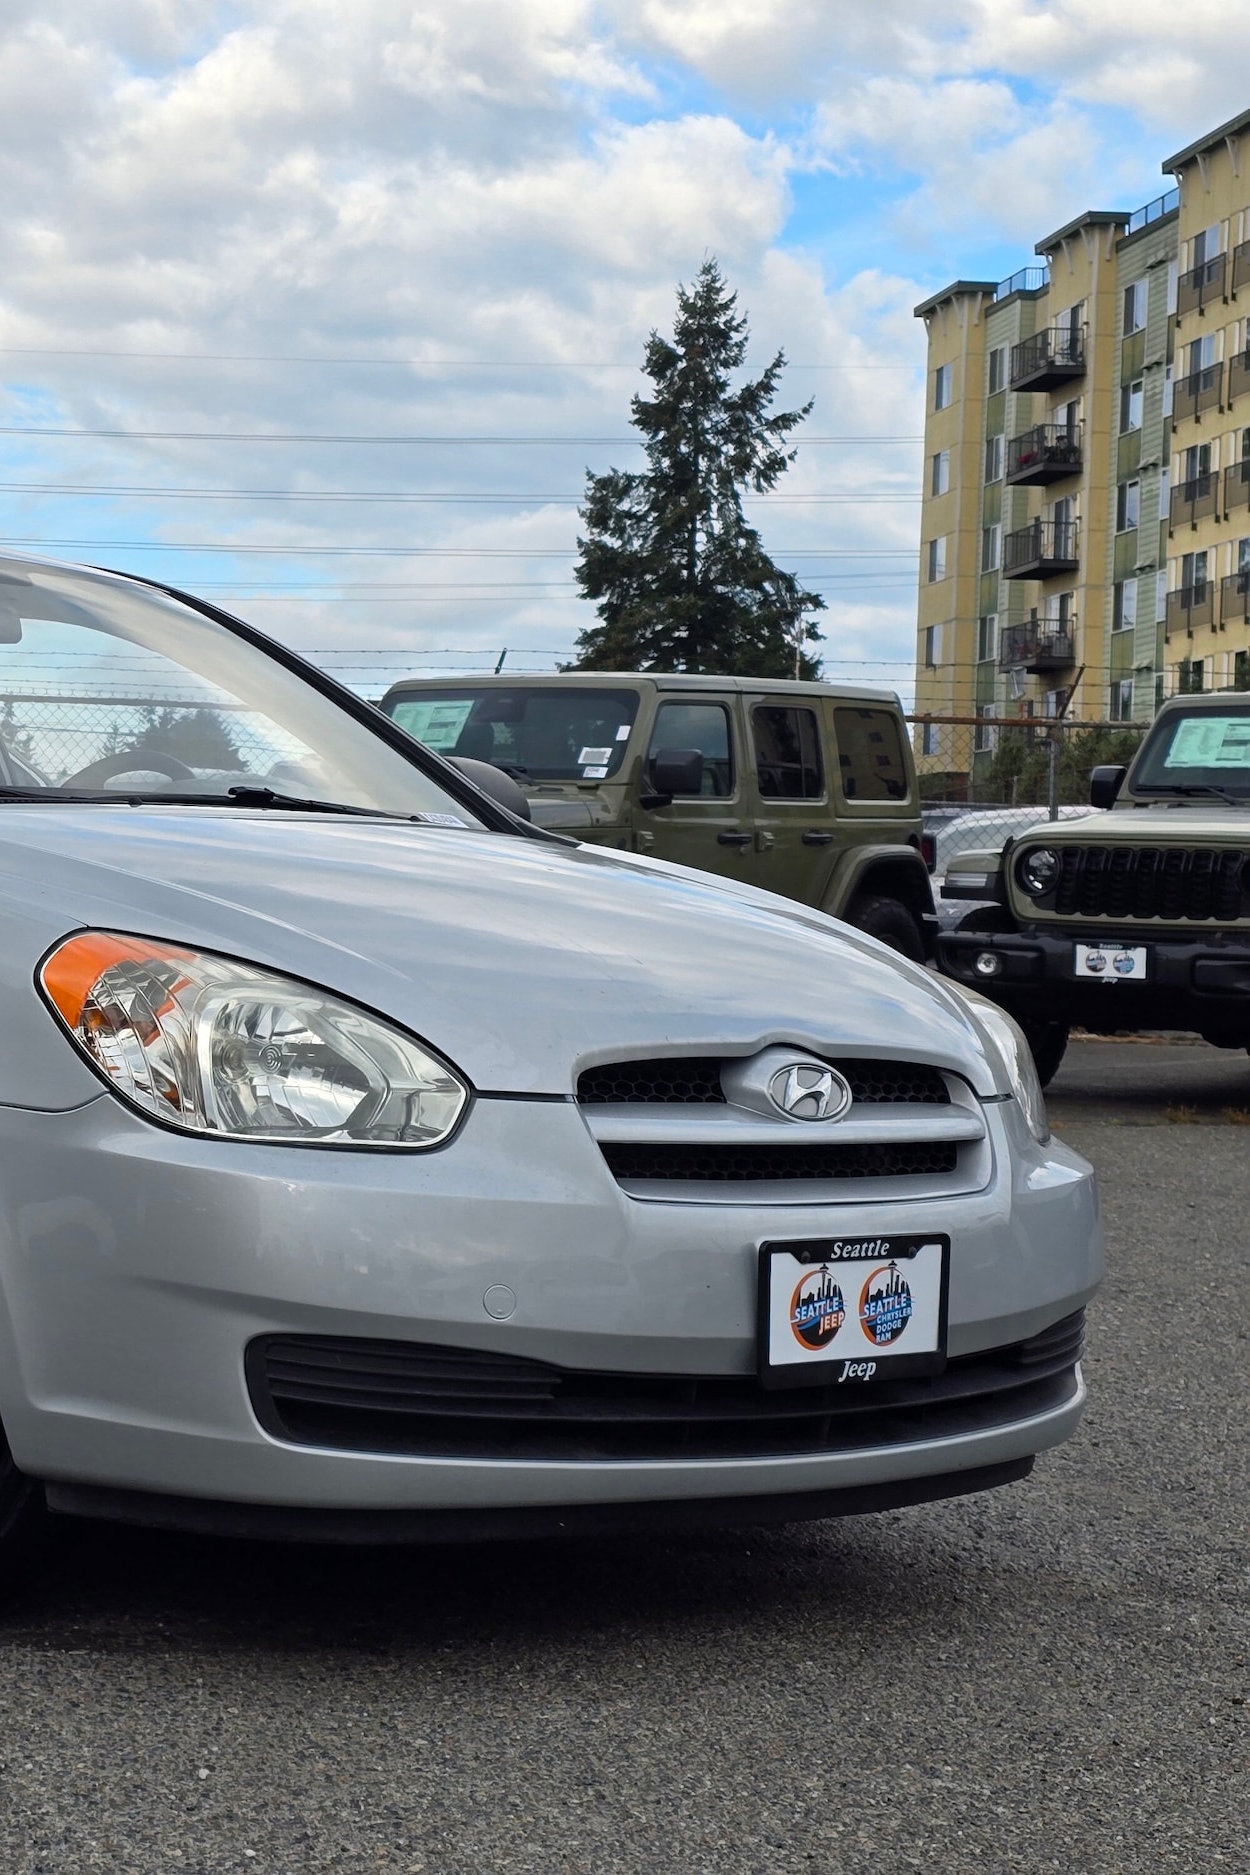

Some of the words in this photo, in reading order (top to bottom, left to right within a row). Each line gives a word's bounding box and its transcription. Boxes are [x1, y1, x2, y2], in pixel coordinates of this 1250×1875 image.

[830, 1239, 890, 1259] Seattle
[795, 1296, 839, 1321] SEATTLE
[863, 1293, 907, 1317] SEATTLE
[876, 1307, 912, 1324] CHRYSLER
[819, 1311, 845, 1335] JEEP
[876, 1319, 902, 1335] DODGE
[875, 1333, 892, 1344] RAM
[838, 1360, 876, 1382] Jeep
